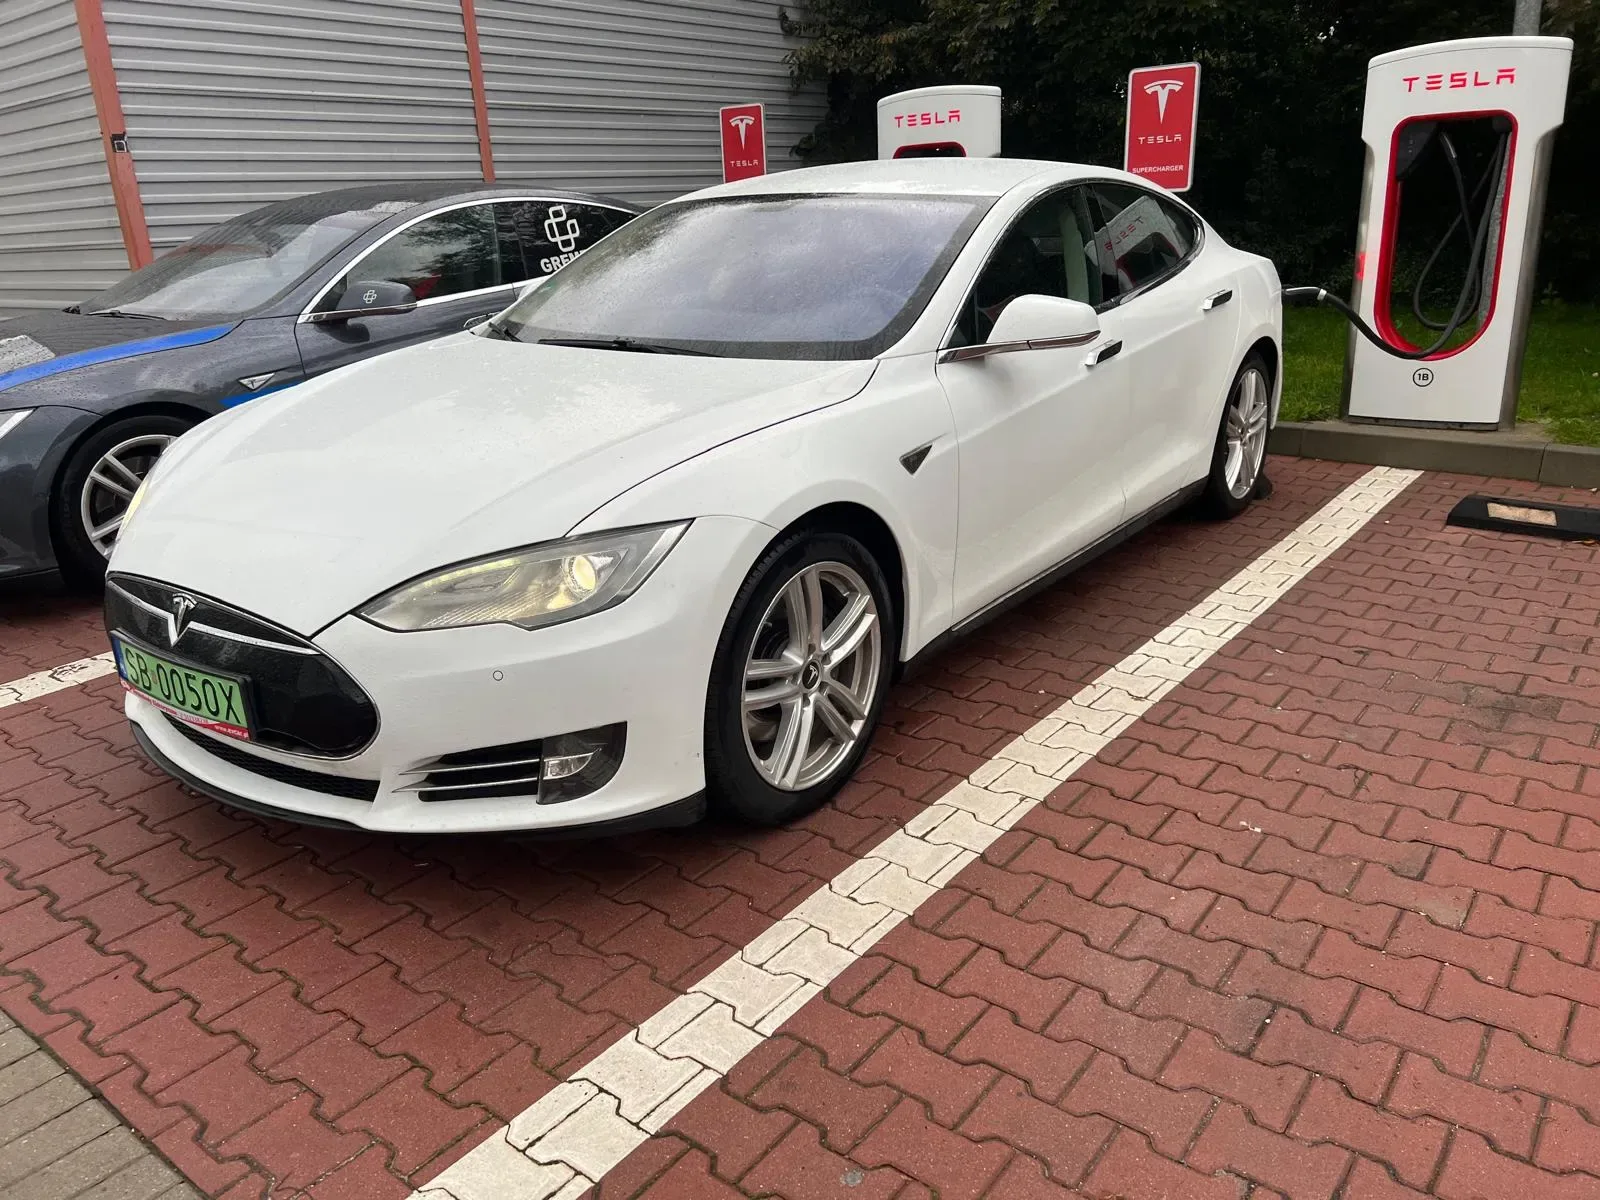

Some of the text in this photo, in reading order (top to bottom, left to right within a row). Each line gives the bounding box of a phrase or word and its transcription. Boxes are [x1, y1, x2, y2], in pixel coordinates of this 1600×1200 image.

[1402, 68, 1516, 93] TESLA
[894, 109, 961, 129] TESLA
[1138, 133, 1182, 145] TESLA
[729, 159, 759, 167] TESLA
[1132, 164, 1184, 175] SUPERCHARGER
[1417, 373, 1429, 381] 1B
[125, 647, 152, 691] SB
